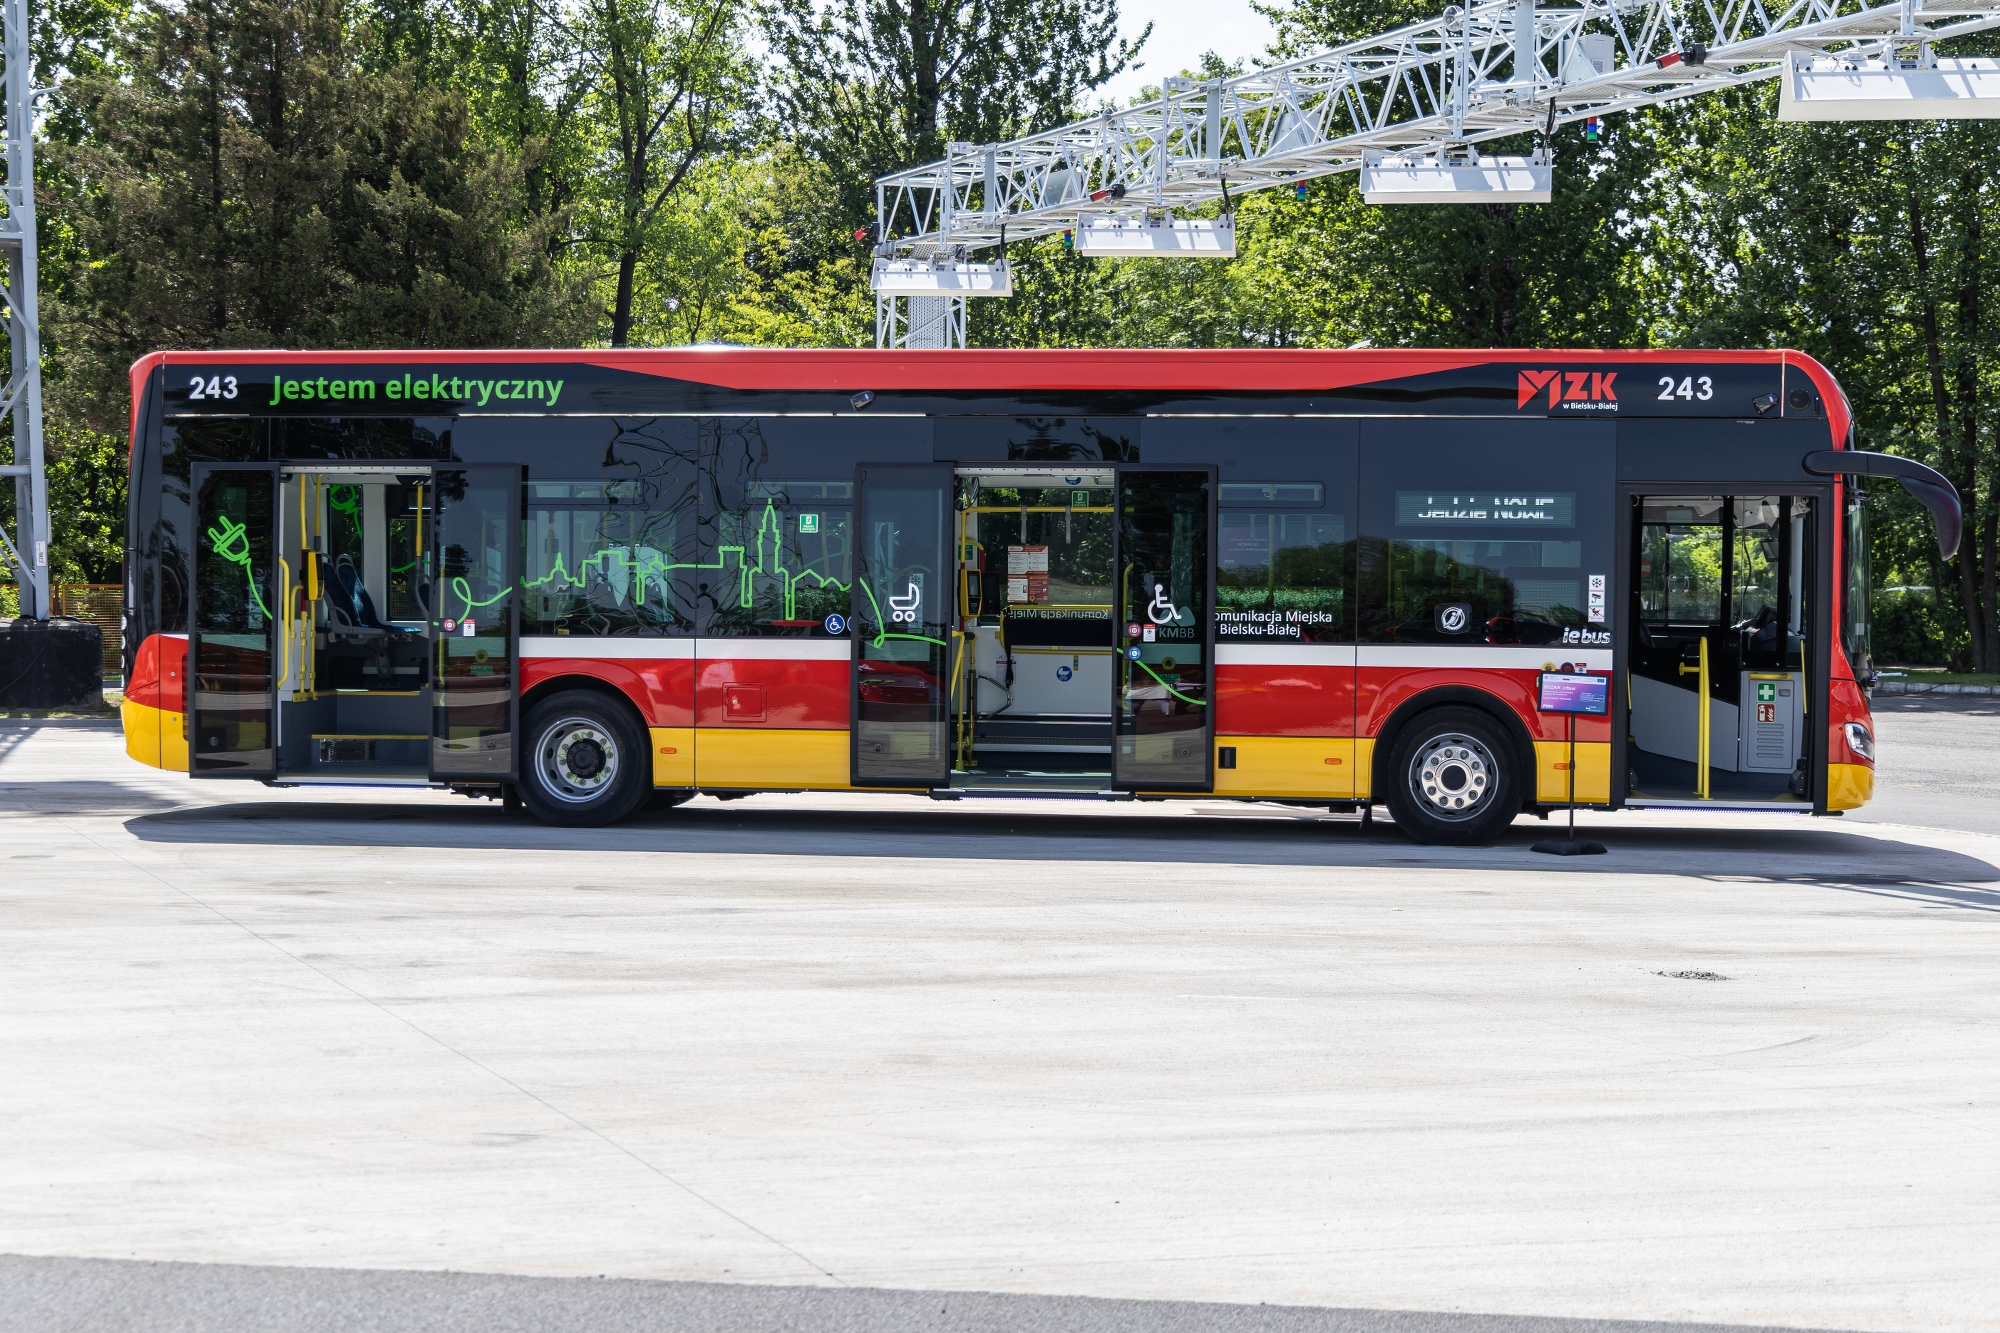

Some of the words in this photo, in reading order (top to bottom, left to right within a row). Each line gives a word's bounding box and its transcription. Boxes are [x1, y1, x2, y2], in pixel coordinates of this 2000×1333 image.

[188, 375, 239, 400] 243
[269, 375, 376, 405] Jestem
[385, 373, 564, 406] elektryczny
[1517, 370, 1618, 410] MZK
[1657, 376, 1714, 400] 243
[1570, 402, 1618, 411] Bielsku-Białej
[1214, 610, 1282, 624] omunikacja
[1285, 610, 1332, 624] Miejska
[1158, 627, 1195, 638] KMBB
[1219, 623, 1301, 637] Bielsku-Białej
